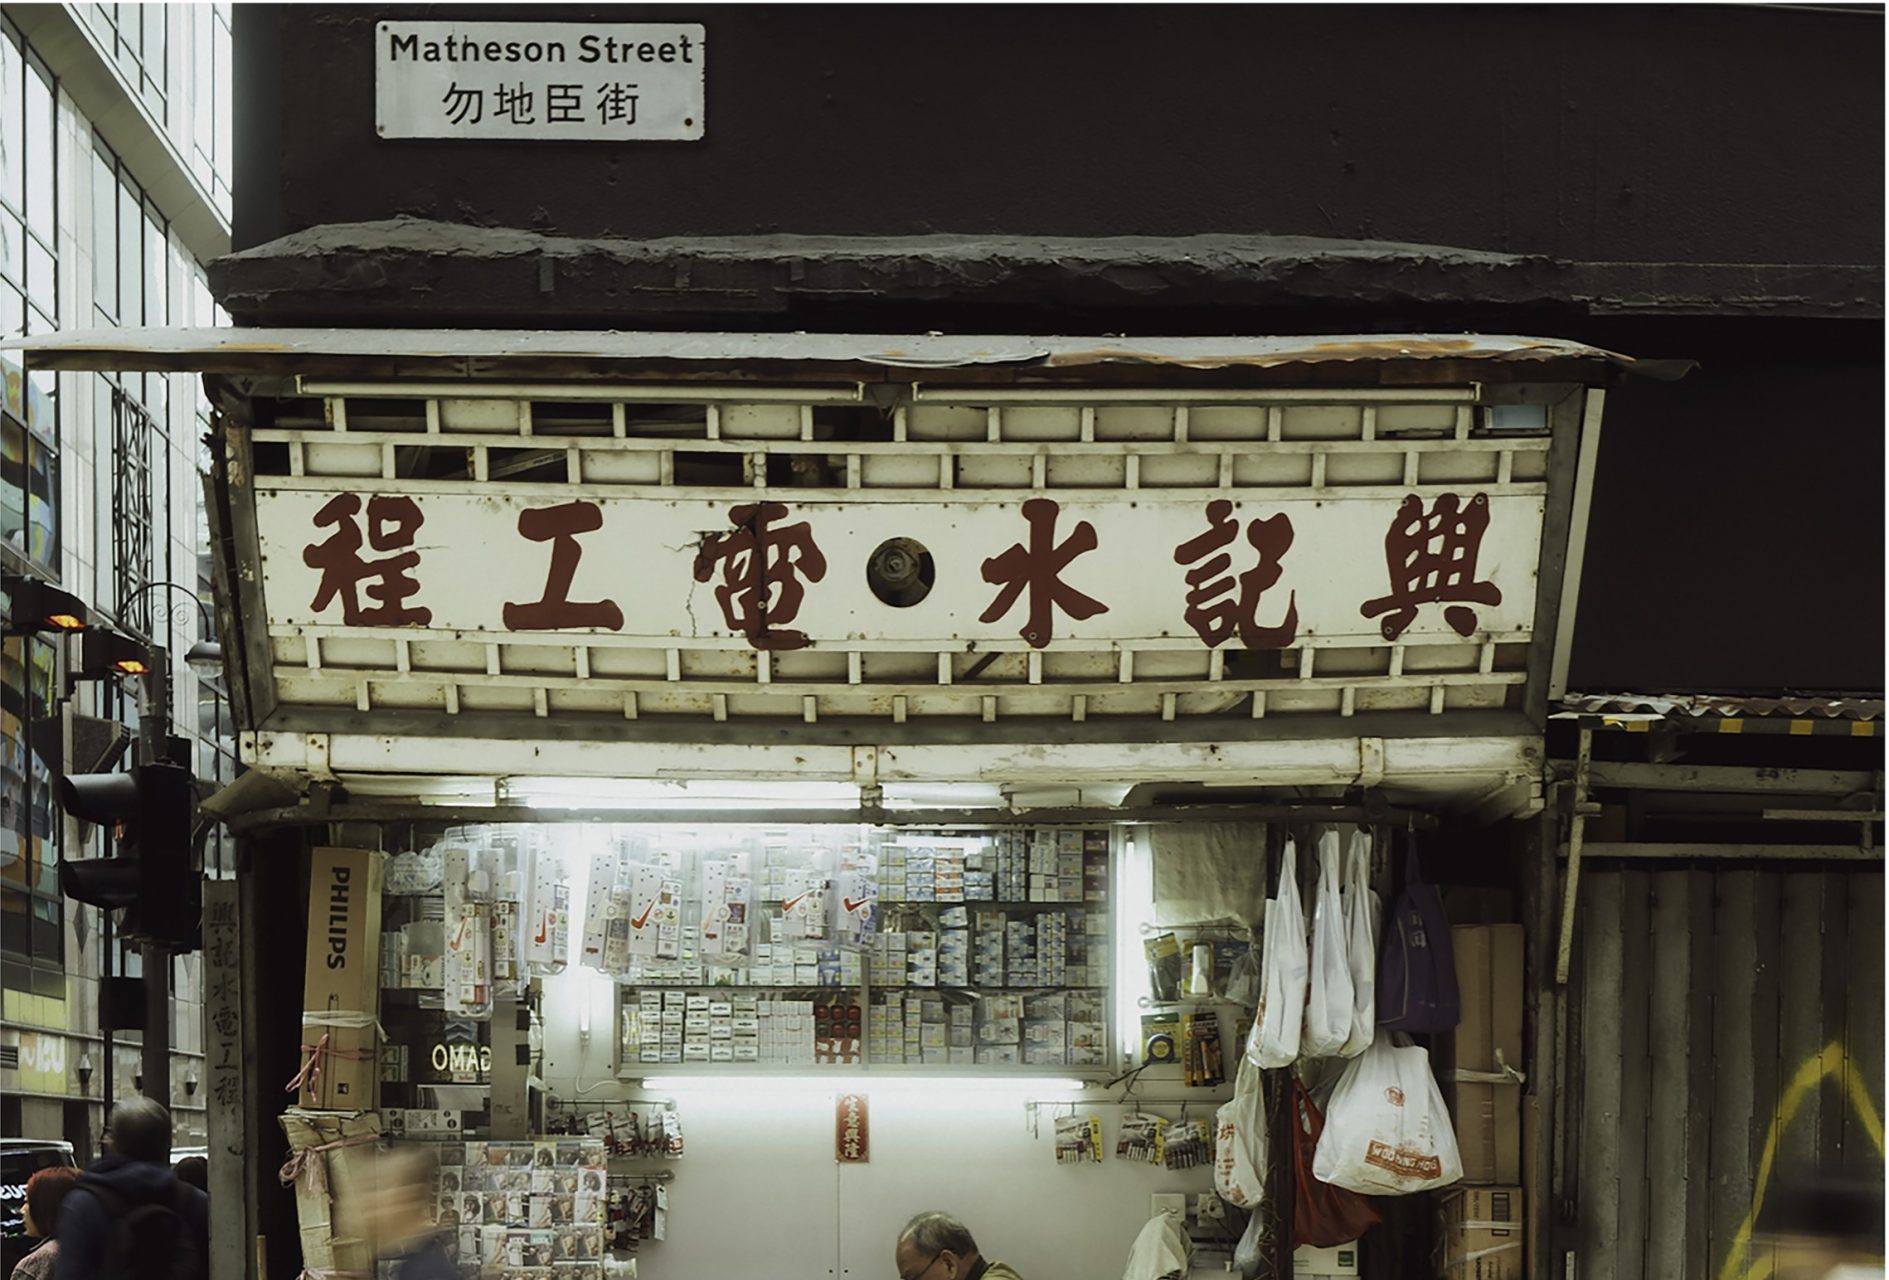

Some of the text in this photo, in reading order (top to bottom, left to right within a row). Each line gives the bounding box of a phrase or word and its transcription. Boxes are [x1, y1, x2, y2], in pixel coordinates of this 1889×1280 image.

[389, 34, 693, 64] Matheson Street
[441, 82, 640, 126] 勿地臣街
[327, 866, 350, 970] PHILIPS
